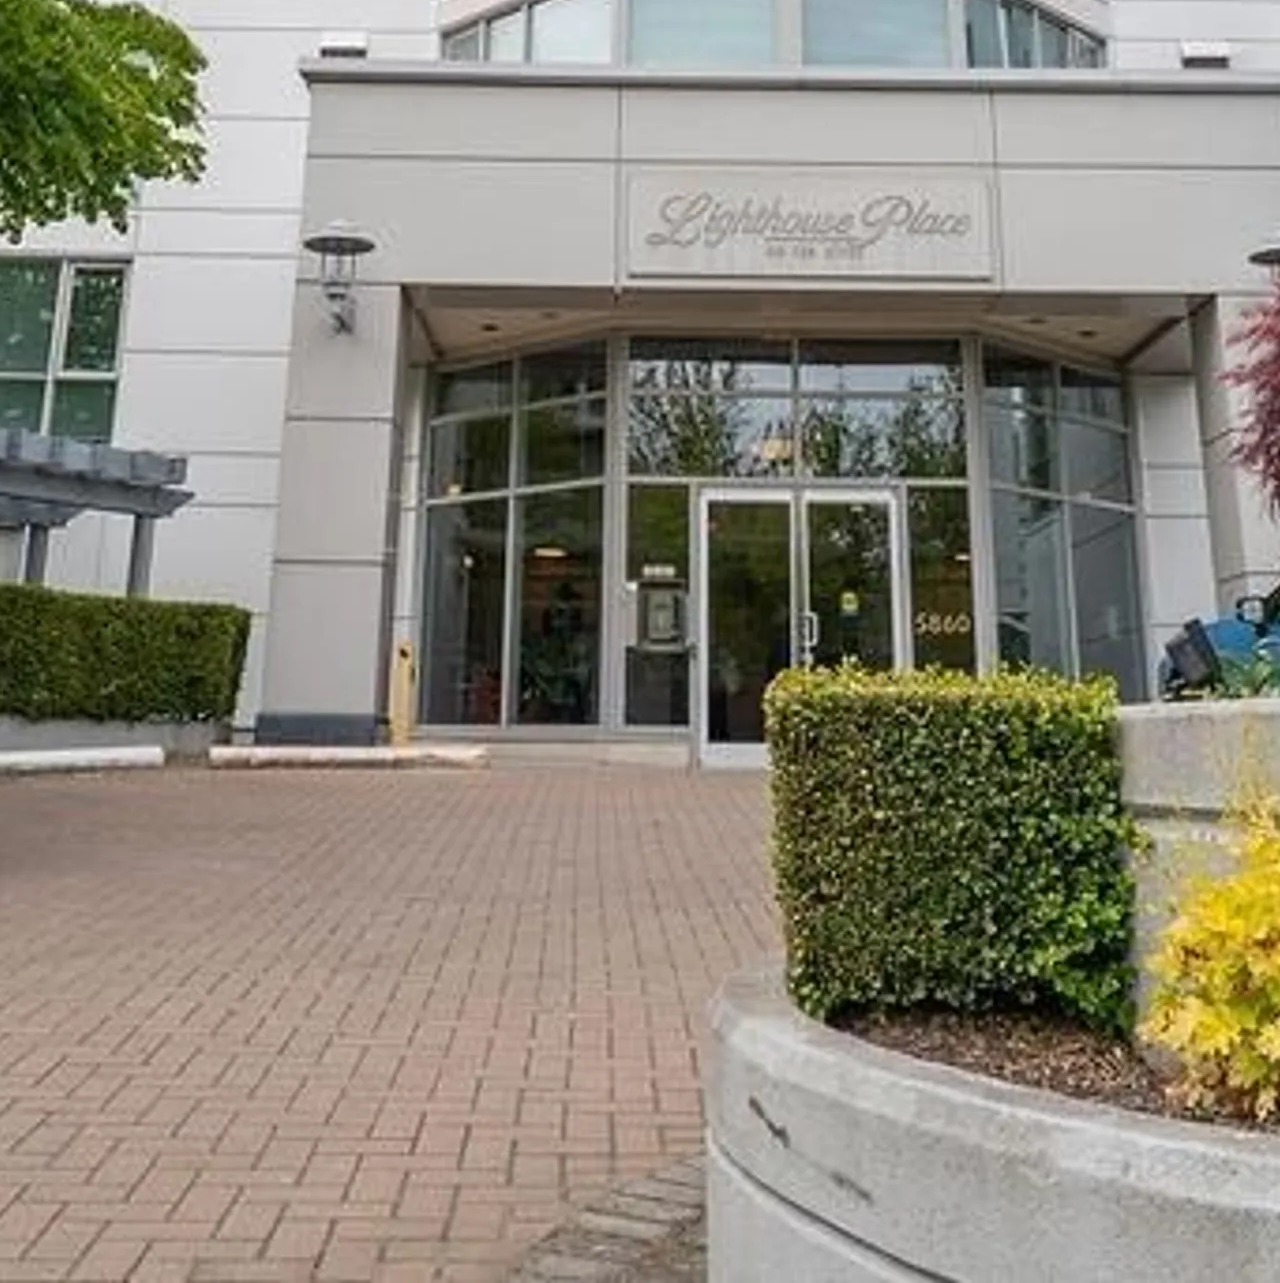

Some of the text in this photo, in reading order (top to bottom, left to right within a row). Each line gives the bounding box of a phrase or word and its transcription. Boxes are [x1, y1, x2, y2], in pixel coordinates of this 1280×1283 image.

[646, 192, 972, 249] Lighthouse Place
[915, 611, 971, 635] 5860
